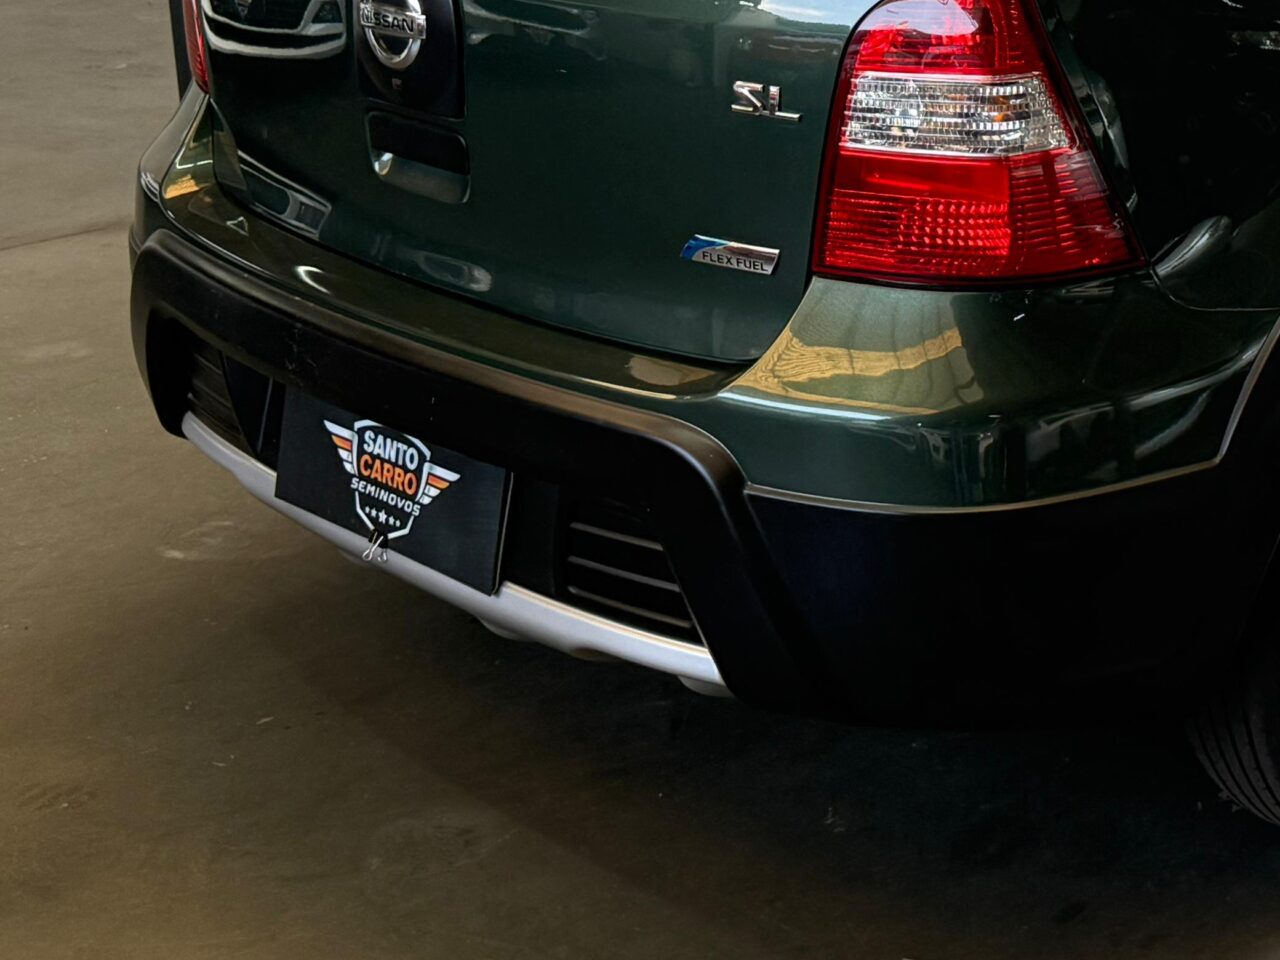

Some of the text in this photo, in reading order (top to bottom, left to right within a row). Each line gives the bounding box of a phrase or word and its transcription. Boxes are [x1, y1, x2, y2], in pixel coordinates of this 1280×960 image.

[362, 6, 414, 34] NISSAN
[731, 80, 802, 121] SL
[701, 250, 769, 272] FLEX FUEL
[363, 429, 419, 471] SANTO
[359, 454, 418, 496] CARRO
[350, 476, 421, 517] SEMINOVOS
